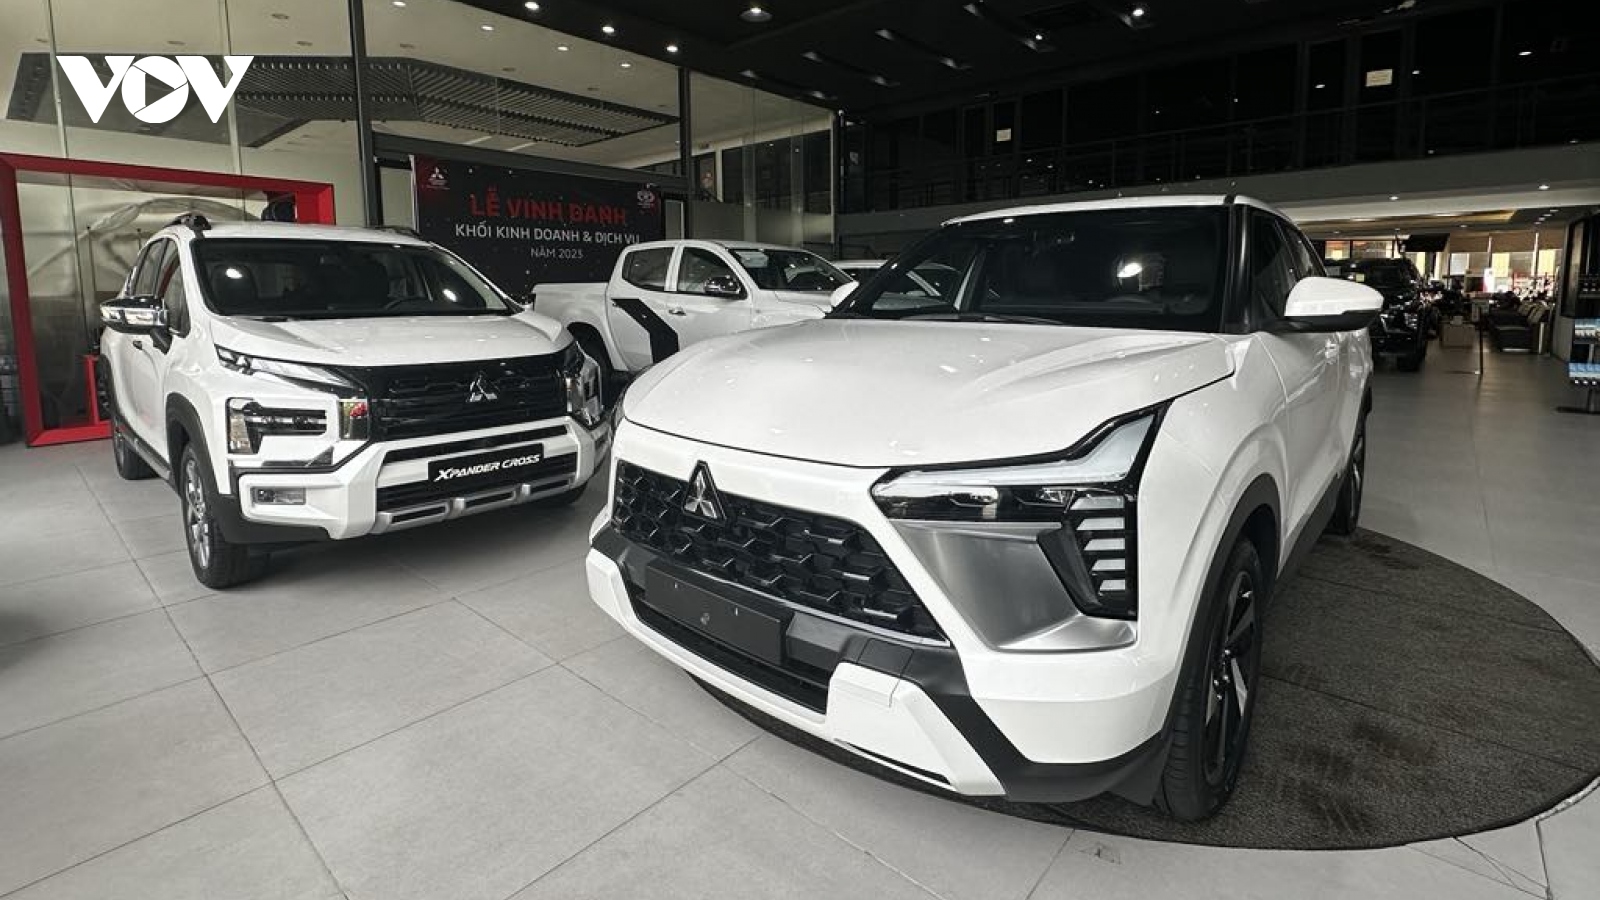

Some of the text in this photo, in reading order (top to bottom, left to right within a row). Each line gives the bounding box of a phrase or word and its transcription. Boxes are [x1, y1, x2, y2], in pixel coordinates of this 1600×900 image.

[506, 197, 562, 221] VINH
[569, 203, 626, 225] DANH
[455, 220, 492, 238] KHỐI
[496, 226, 531, 239] KINH
[534, 227, 579, 242] DOANH
[582, 230, 593, 243] &
[594, 231, 623, 247] DỊCH
[433, 454, 540, 482] XPANDER CROSS
